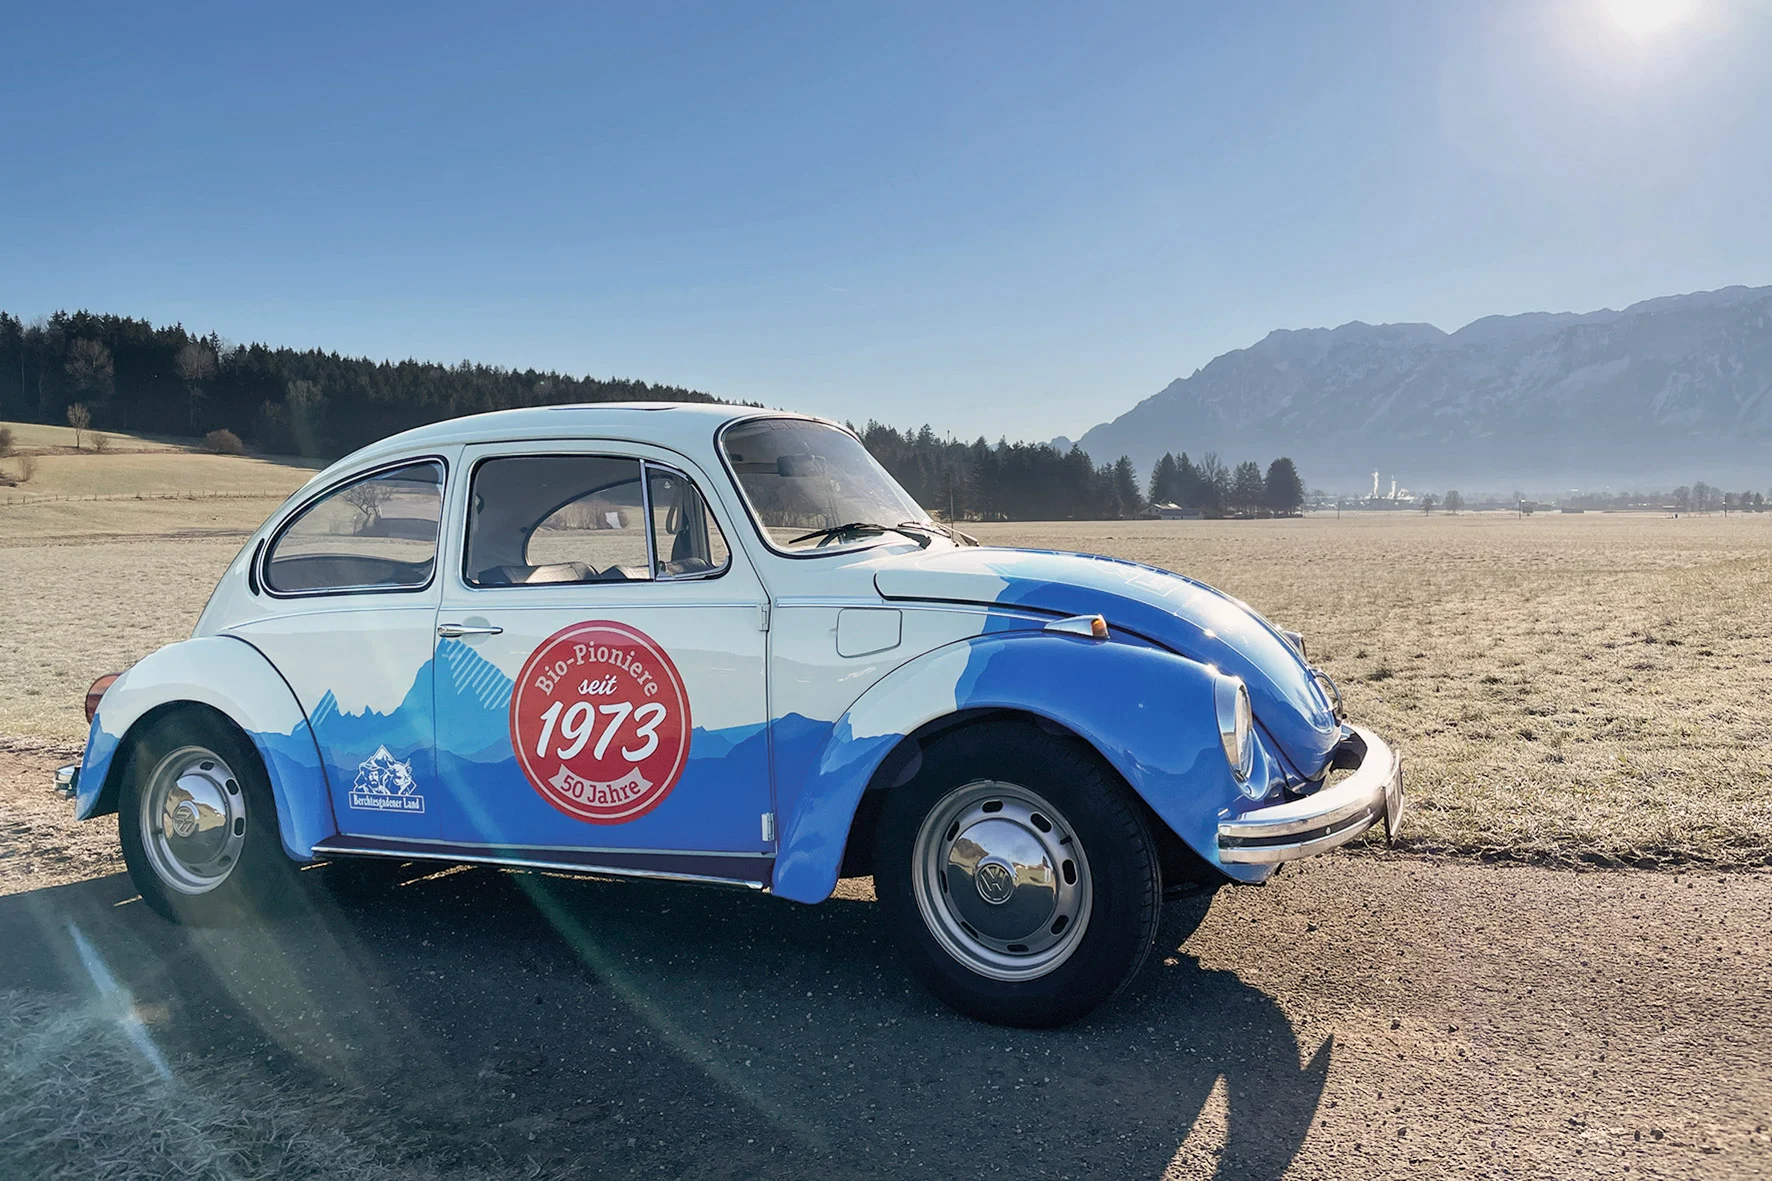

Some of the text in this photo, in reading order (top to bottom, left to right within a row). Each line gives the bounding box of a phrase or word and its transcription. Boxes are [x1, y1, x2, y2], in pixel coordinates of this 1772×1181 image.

[535, 641, 659, 696] Bio-Pioniere
[578, 674, 618, 695] seit
[536, 700, 667, 762] 1973
[353, 794, 420, 809] Berchtesgadener Land
[560, 774, 641, 804] 50 Jahre
